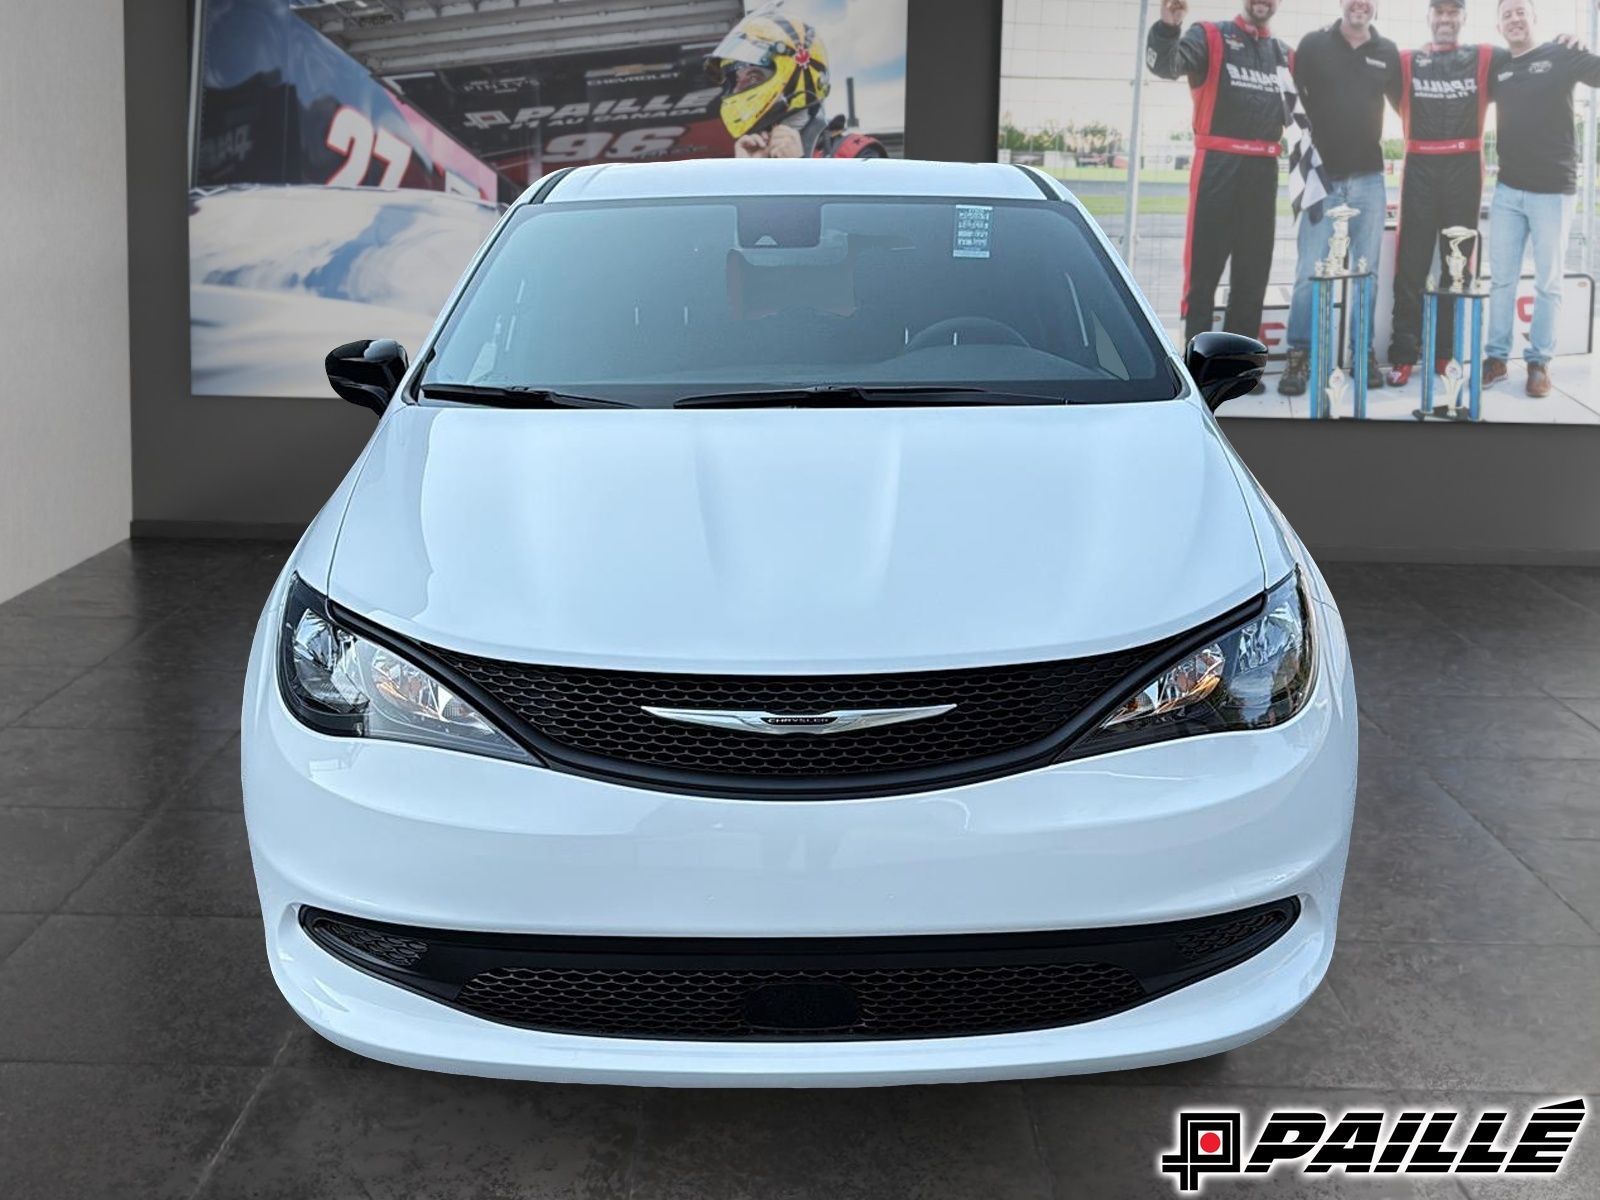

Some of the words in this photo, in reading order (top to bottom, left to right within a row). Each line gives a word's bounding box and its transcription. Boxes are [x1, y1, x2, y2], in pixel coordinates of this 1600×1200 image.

[586, 72, 680, 86] CHEVROLET
[327, 105, 412, 190] 27
[542, 126, 686, 163] 96
